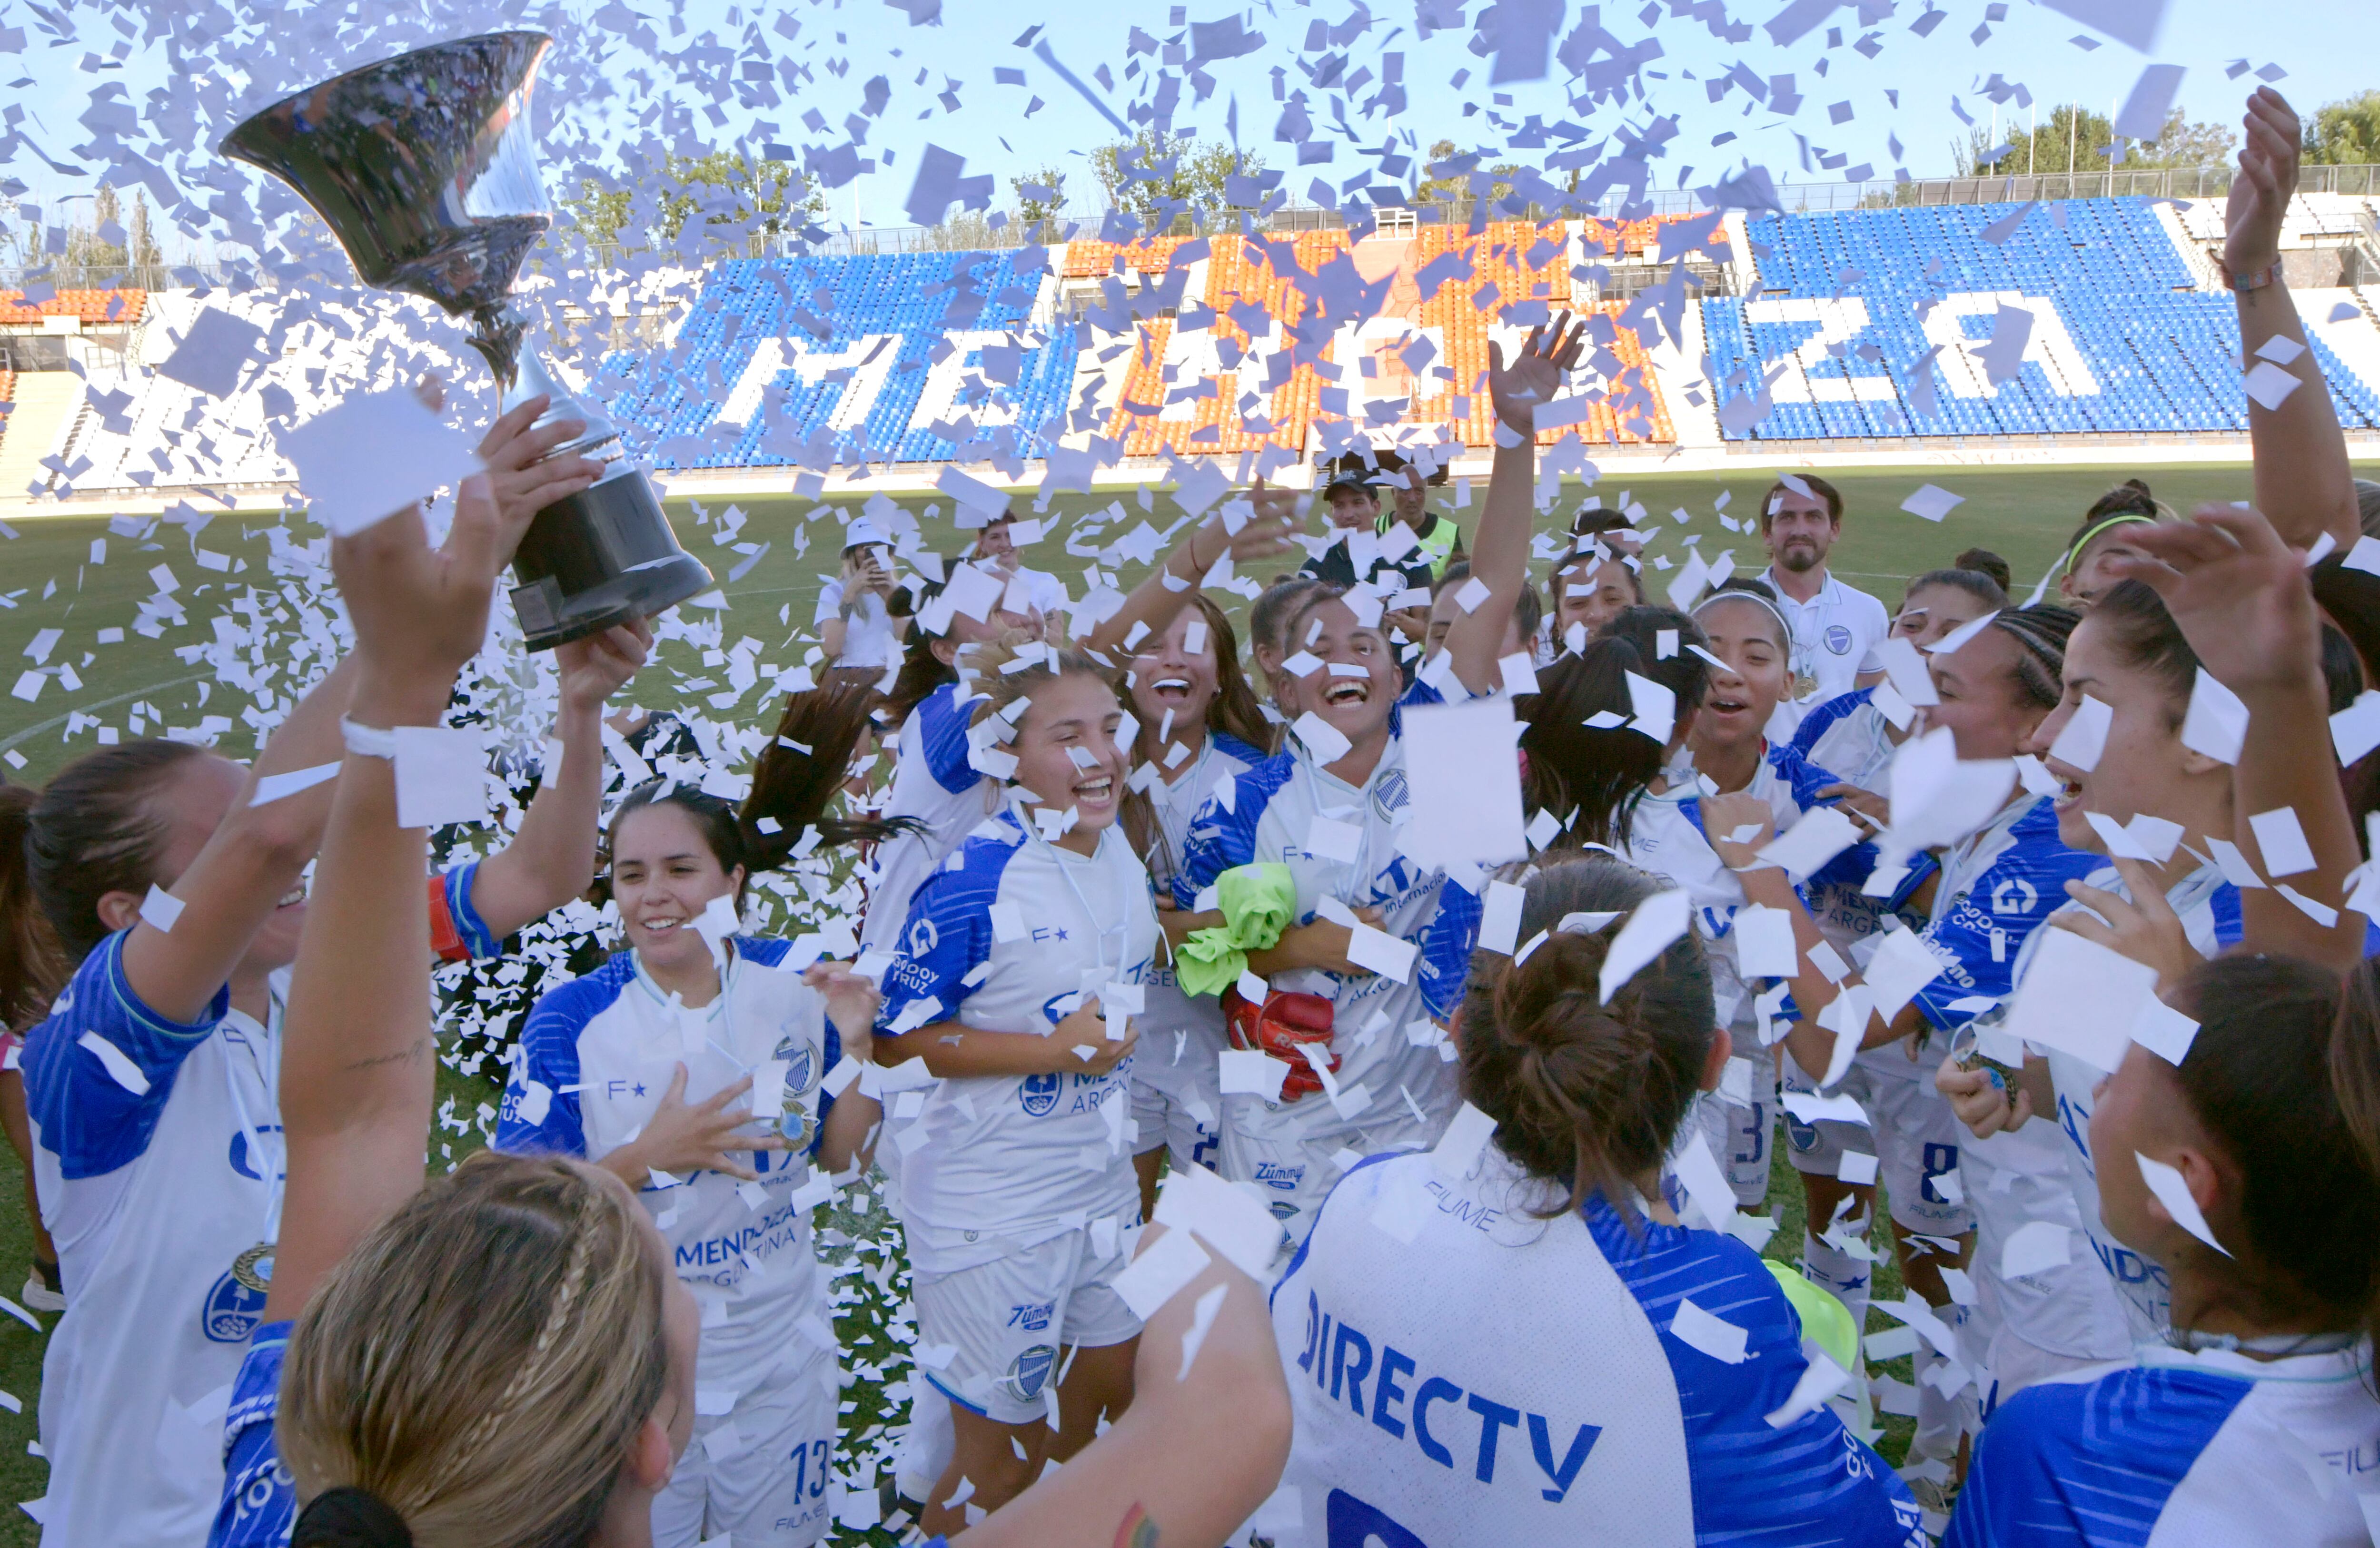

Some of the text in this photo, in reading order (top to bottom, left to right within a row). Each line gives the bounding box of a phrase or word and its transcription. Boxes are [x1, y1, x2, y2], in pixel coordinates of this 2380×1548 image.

[1921, 1143, 1958, 1203] 8
[1424, 1180, 1503, 1232] FIUME
[790, 1439, 827, 1505] 13
